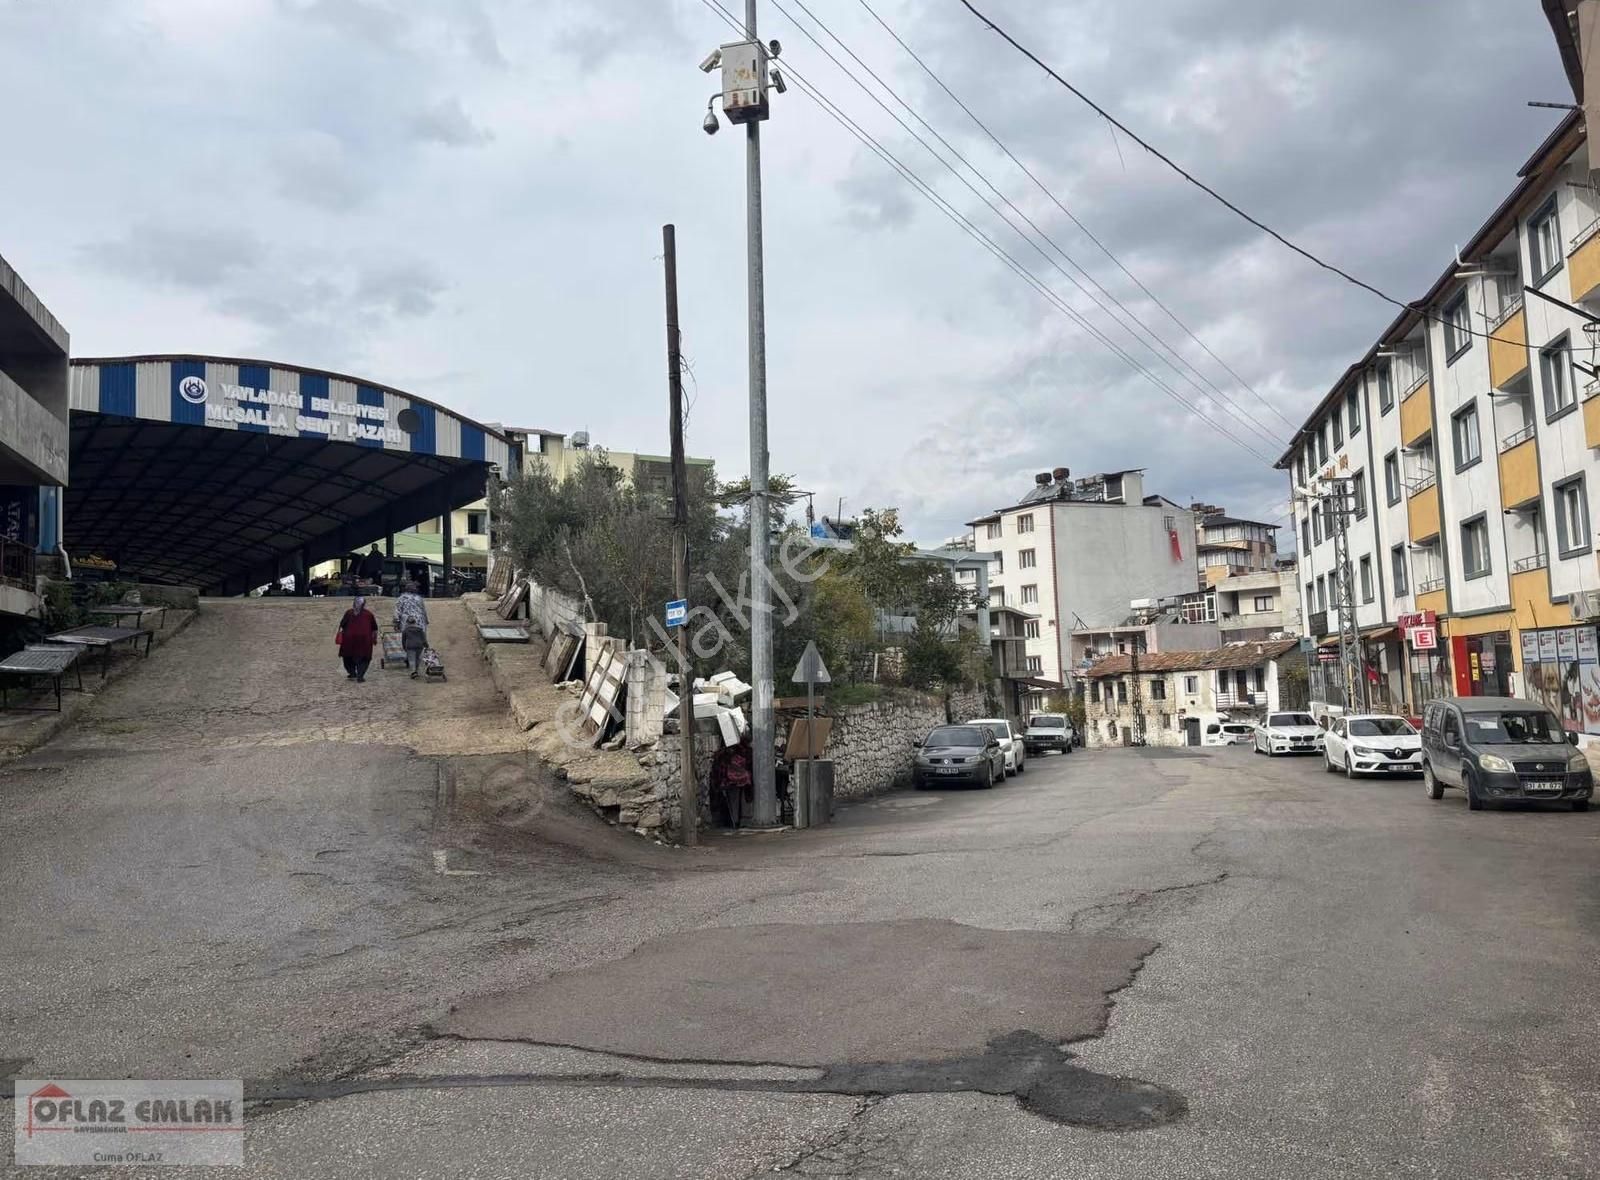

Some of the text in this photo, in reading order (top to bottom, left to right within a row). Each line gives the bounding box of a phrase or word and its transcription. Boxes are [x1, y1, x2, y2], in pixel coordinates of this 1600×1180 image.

[219, 383, 303, 409] YAYLADAĞI
[295, 415, 341, 436] SEMT
[347, 422, 401, 443] PAZARI
